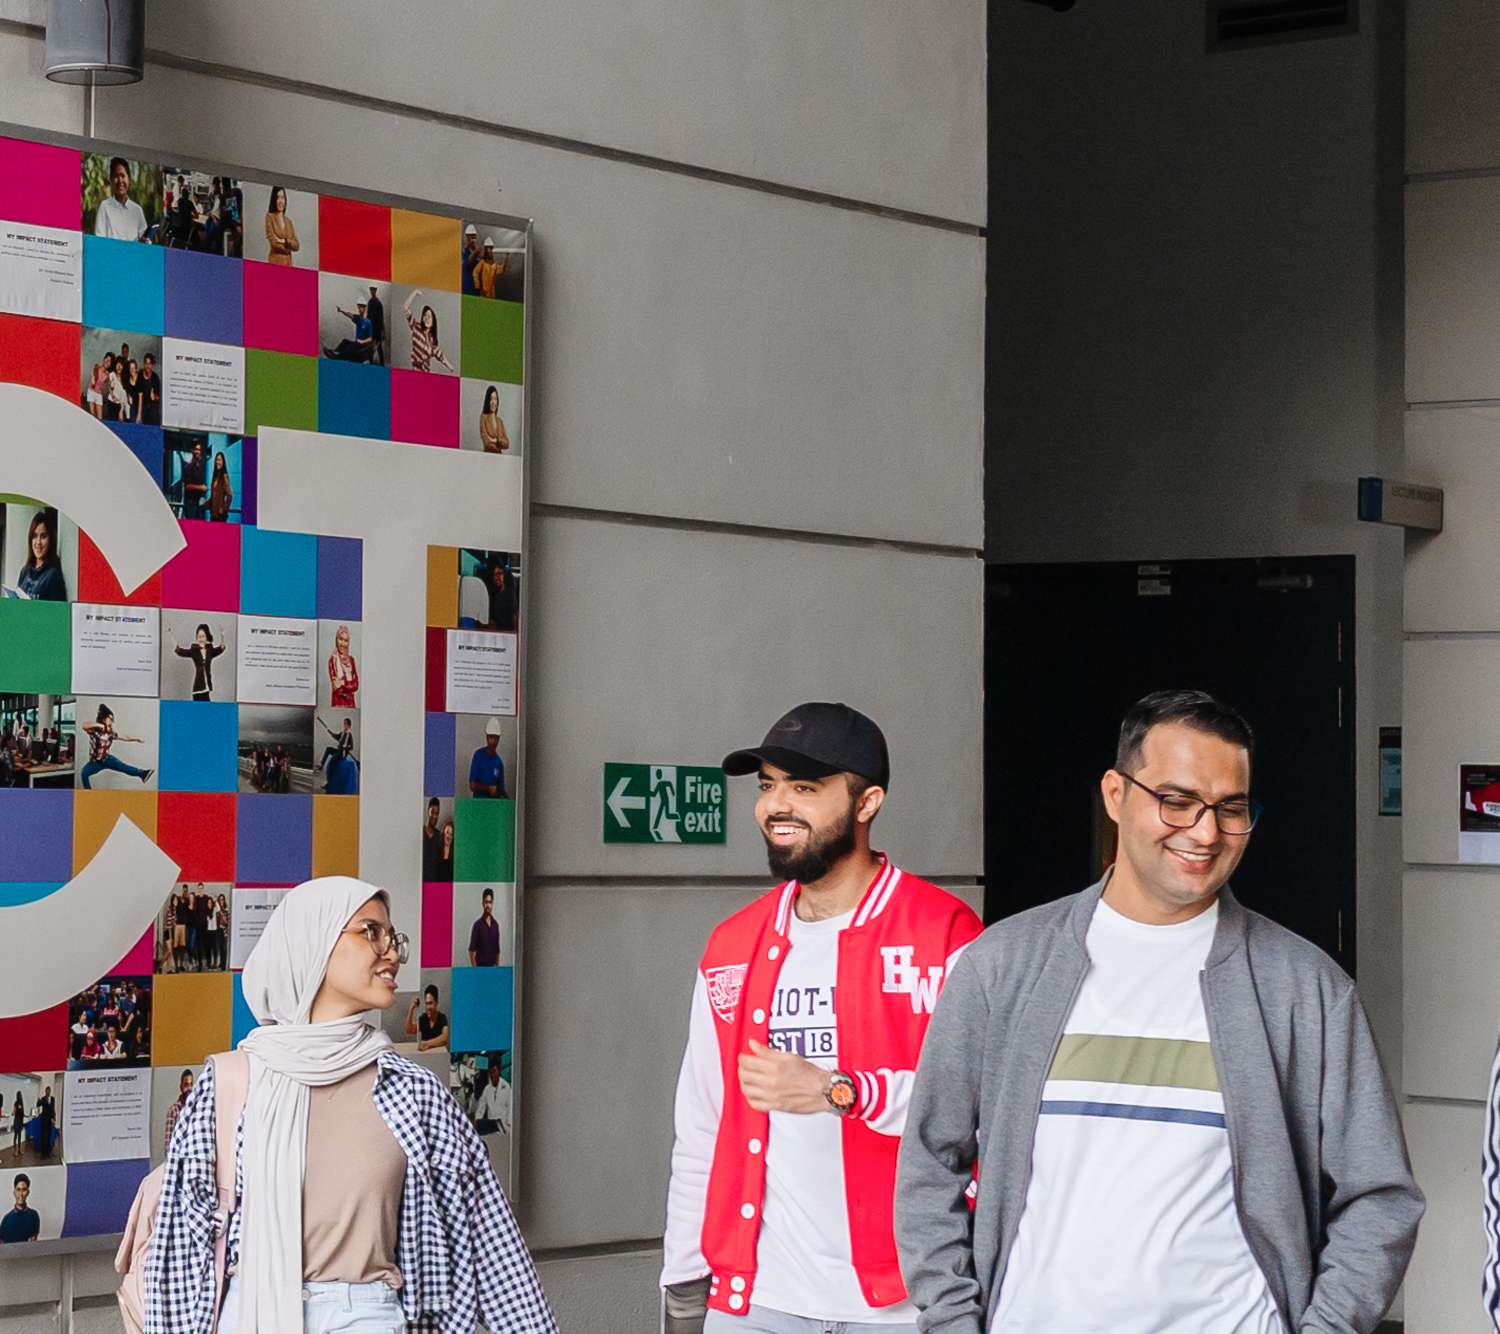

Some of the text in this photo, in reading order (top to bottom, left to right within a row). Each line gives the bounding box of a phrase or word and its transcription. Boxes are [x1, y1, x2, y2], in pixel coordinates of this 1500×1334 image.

[37, 238, 68, 246] STATEMENT
[684, 775, 722, 805] Fire
[683, 806, 722, 834] exit
[770, 986, 836, 1017] IOT-
[811, 1032, 833, 1053] 18
